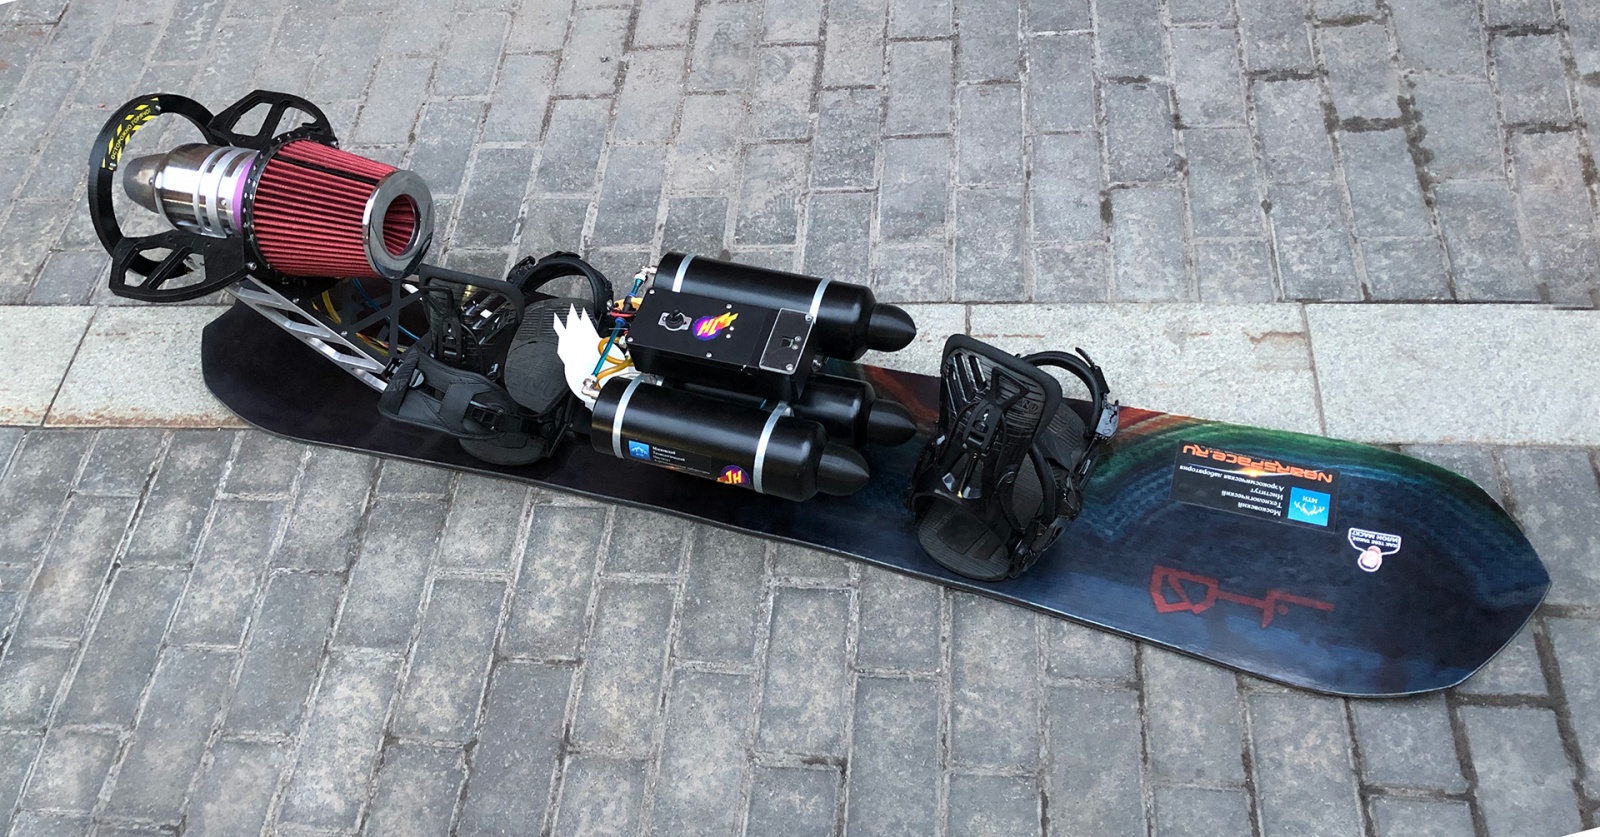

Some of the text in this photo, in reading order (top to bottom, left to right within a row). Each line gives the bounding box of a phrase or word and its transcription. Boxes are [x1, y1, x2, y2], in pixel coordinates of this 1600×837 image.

[110, 124, 132, 160] ОСТОРОЖНО
[1179, 465, 1285, 492] Аэрокосмическая лаборатория
[1221, 490, 1283, 509] Технологический
[1249, 488, 1284, 501] Институт
[1237, 502, 1282, 517] Московский
